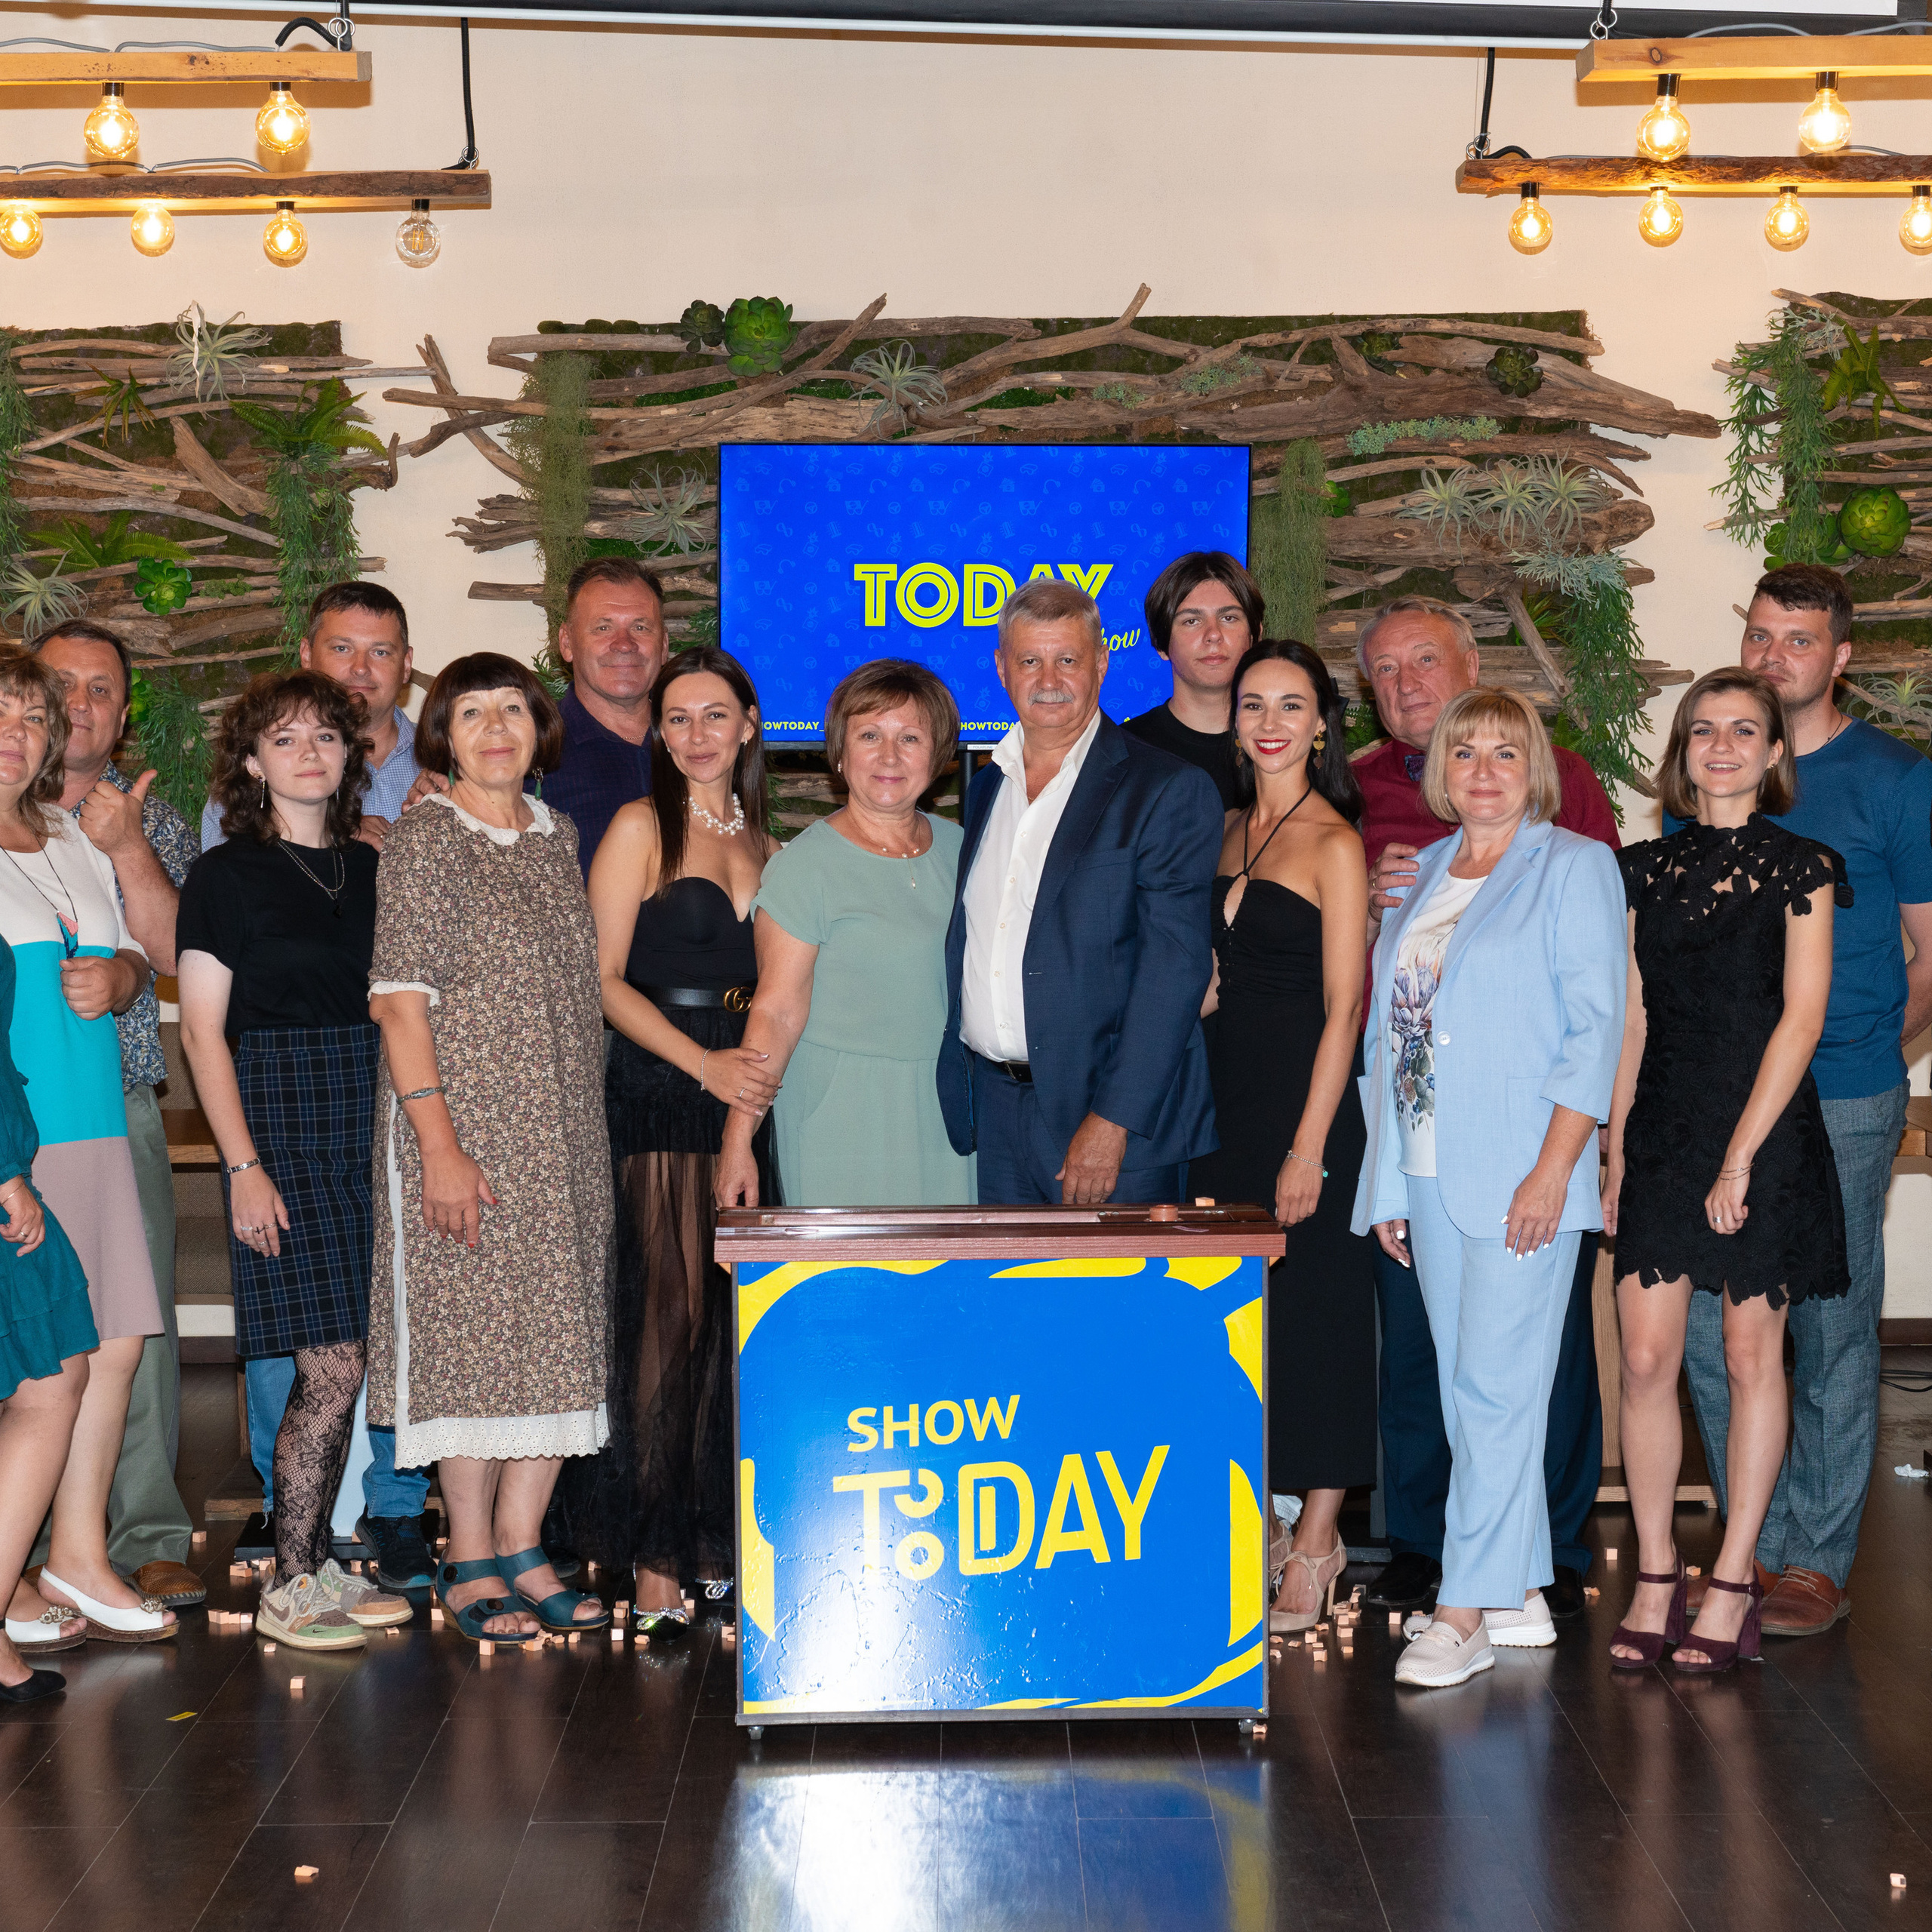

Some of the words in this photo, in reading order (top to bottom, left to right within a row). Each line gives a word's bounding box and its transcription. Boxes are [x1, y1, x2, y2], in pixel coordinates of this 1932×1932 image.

[854, 563, 1113, 628] TODY
[1101, 627, 1140, 651] how
[761, 721, 824, 732] OWTODAY_
[847, 1395, 1020, 1452] SHOW
